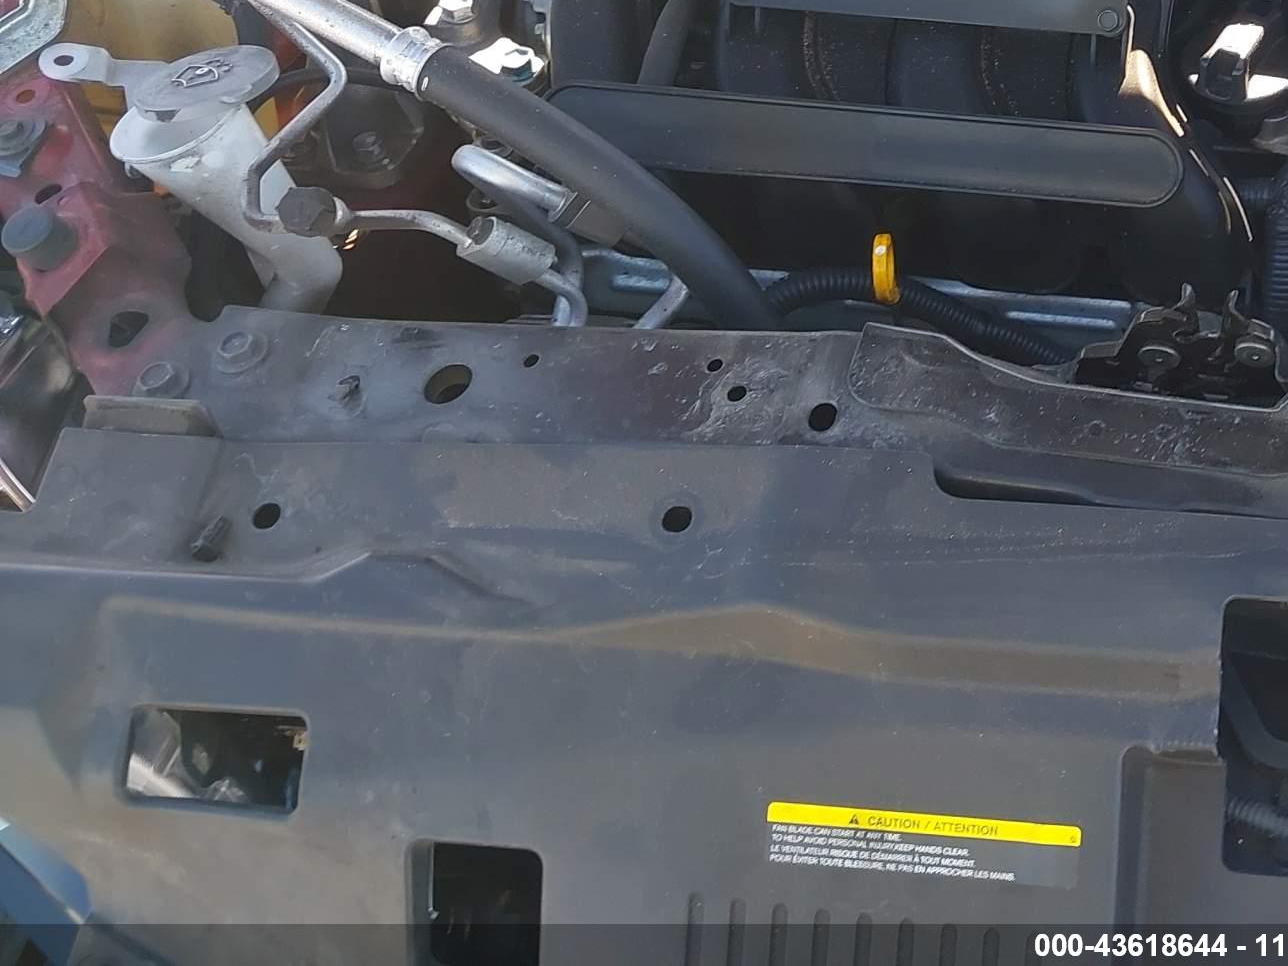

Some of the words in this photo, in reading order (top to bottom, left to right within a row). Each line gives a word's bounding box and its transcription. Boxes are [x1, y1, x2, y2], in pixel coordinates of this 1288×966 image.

[772, 824, 788, 832] FAN
[788, 825, 814, 834] BLADE
[814, 827, 830, 836] CAN
[868, 815, 920, 829] CAUTION
[934, 821, 998, 835] ATTENTION
[770, 844, 780, 852] LE
[830, 849, 859, 859] RISQUE
[860, 850, 870, 859] DE
[920, 855, 941, 865] TOUT
[772, 833, 783, 842] TO
[784, 834, 804, 844] HELP
[804, 836, 827, 845] AVOID
[828, 838, 867, 848] PERSONAL
[915, 844, 942, 855] HANDS
[769, 854, 792, 862] POUR
[819, 857, 844, 867] TOUTE
[886, 862, 897, 871] NE
[898, 863, 914, 872] PAS
[927, 866, 974, 878] APPROCHER
[974, 870, 989, 879] LES
